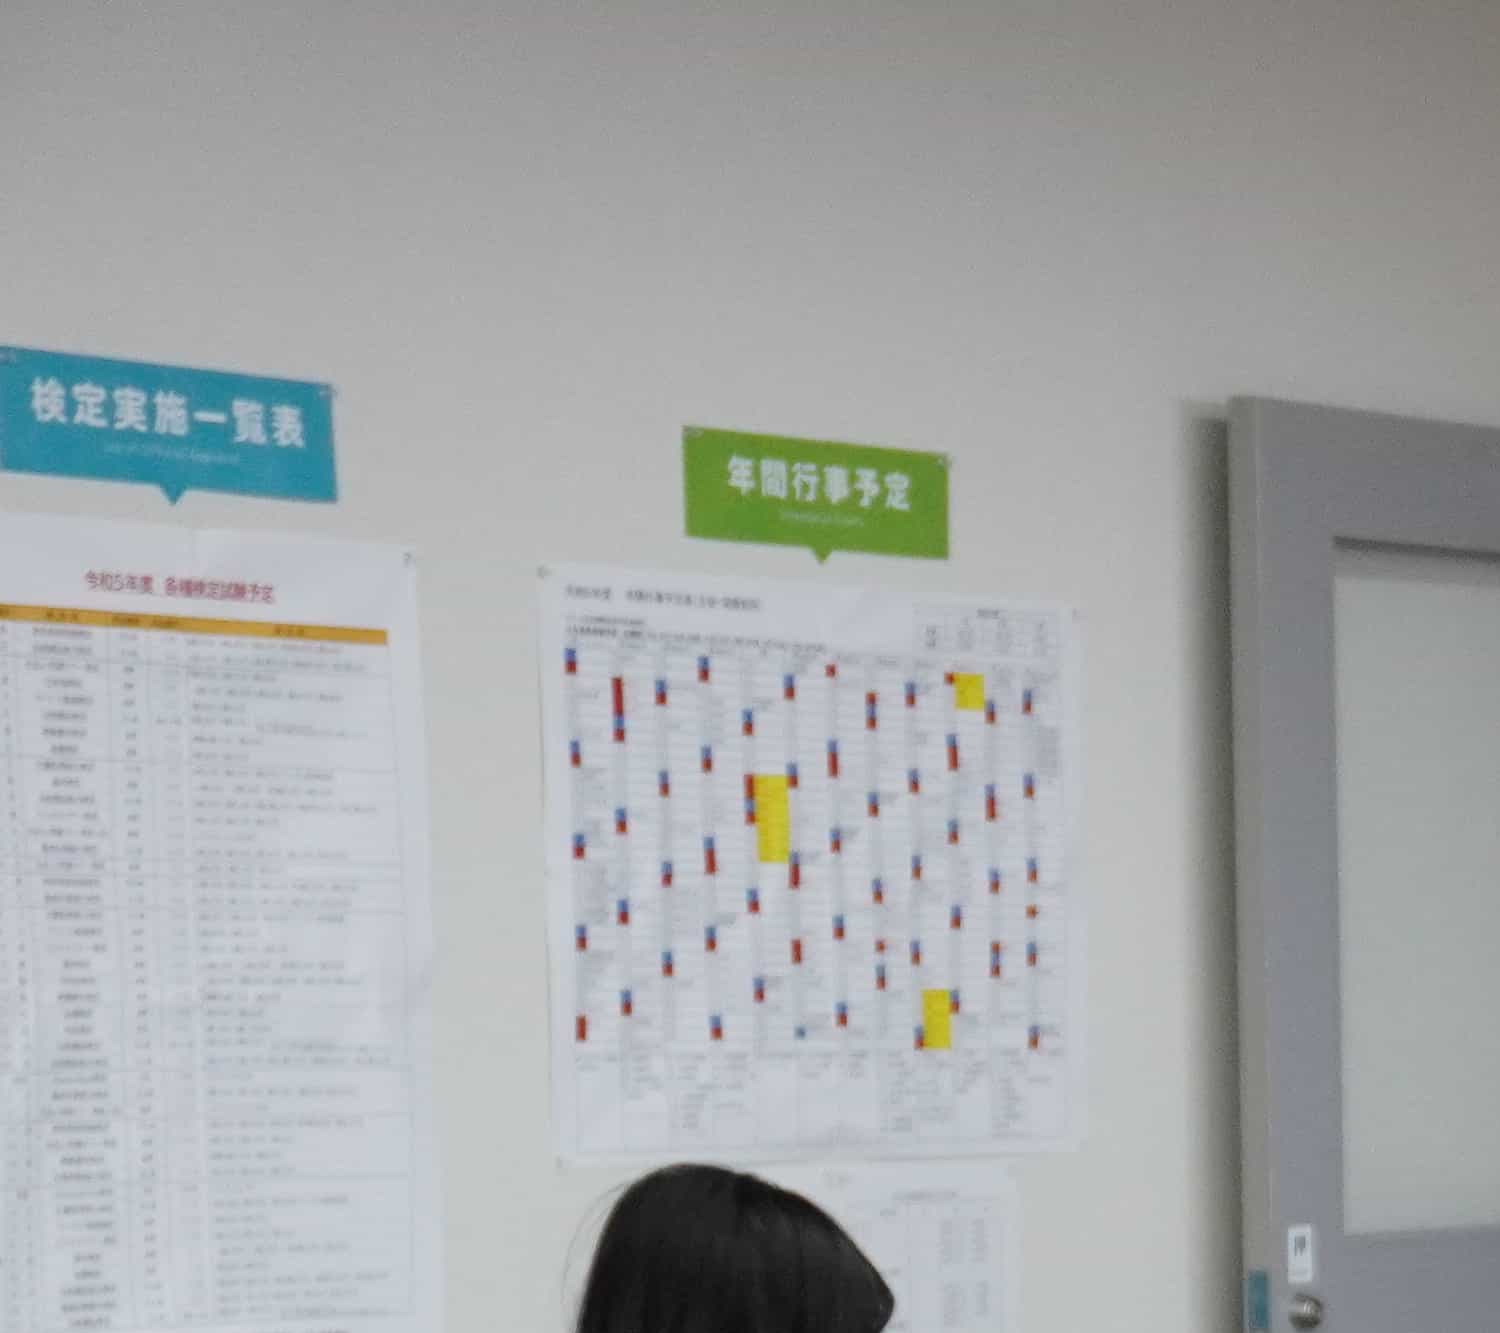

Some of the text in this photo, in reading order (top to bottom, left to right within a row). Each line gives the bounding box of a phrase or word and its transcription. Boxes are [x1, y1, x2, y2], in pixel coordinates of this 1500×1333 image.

[32, 376, 304, 448] 検定実施一覧表
[728, 454, 911, 510] 年間行事予定
